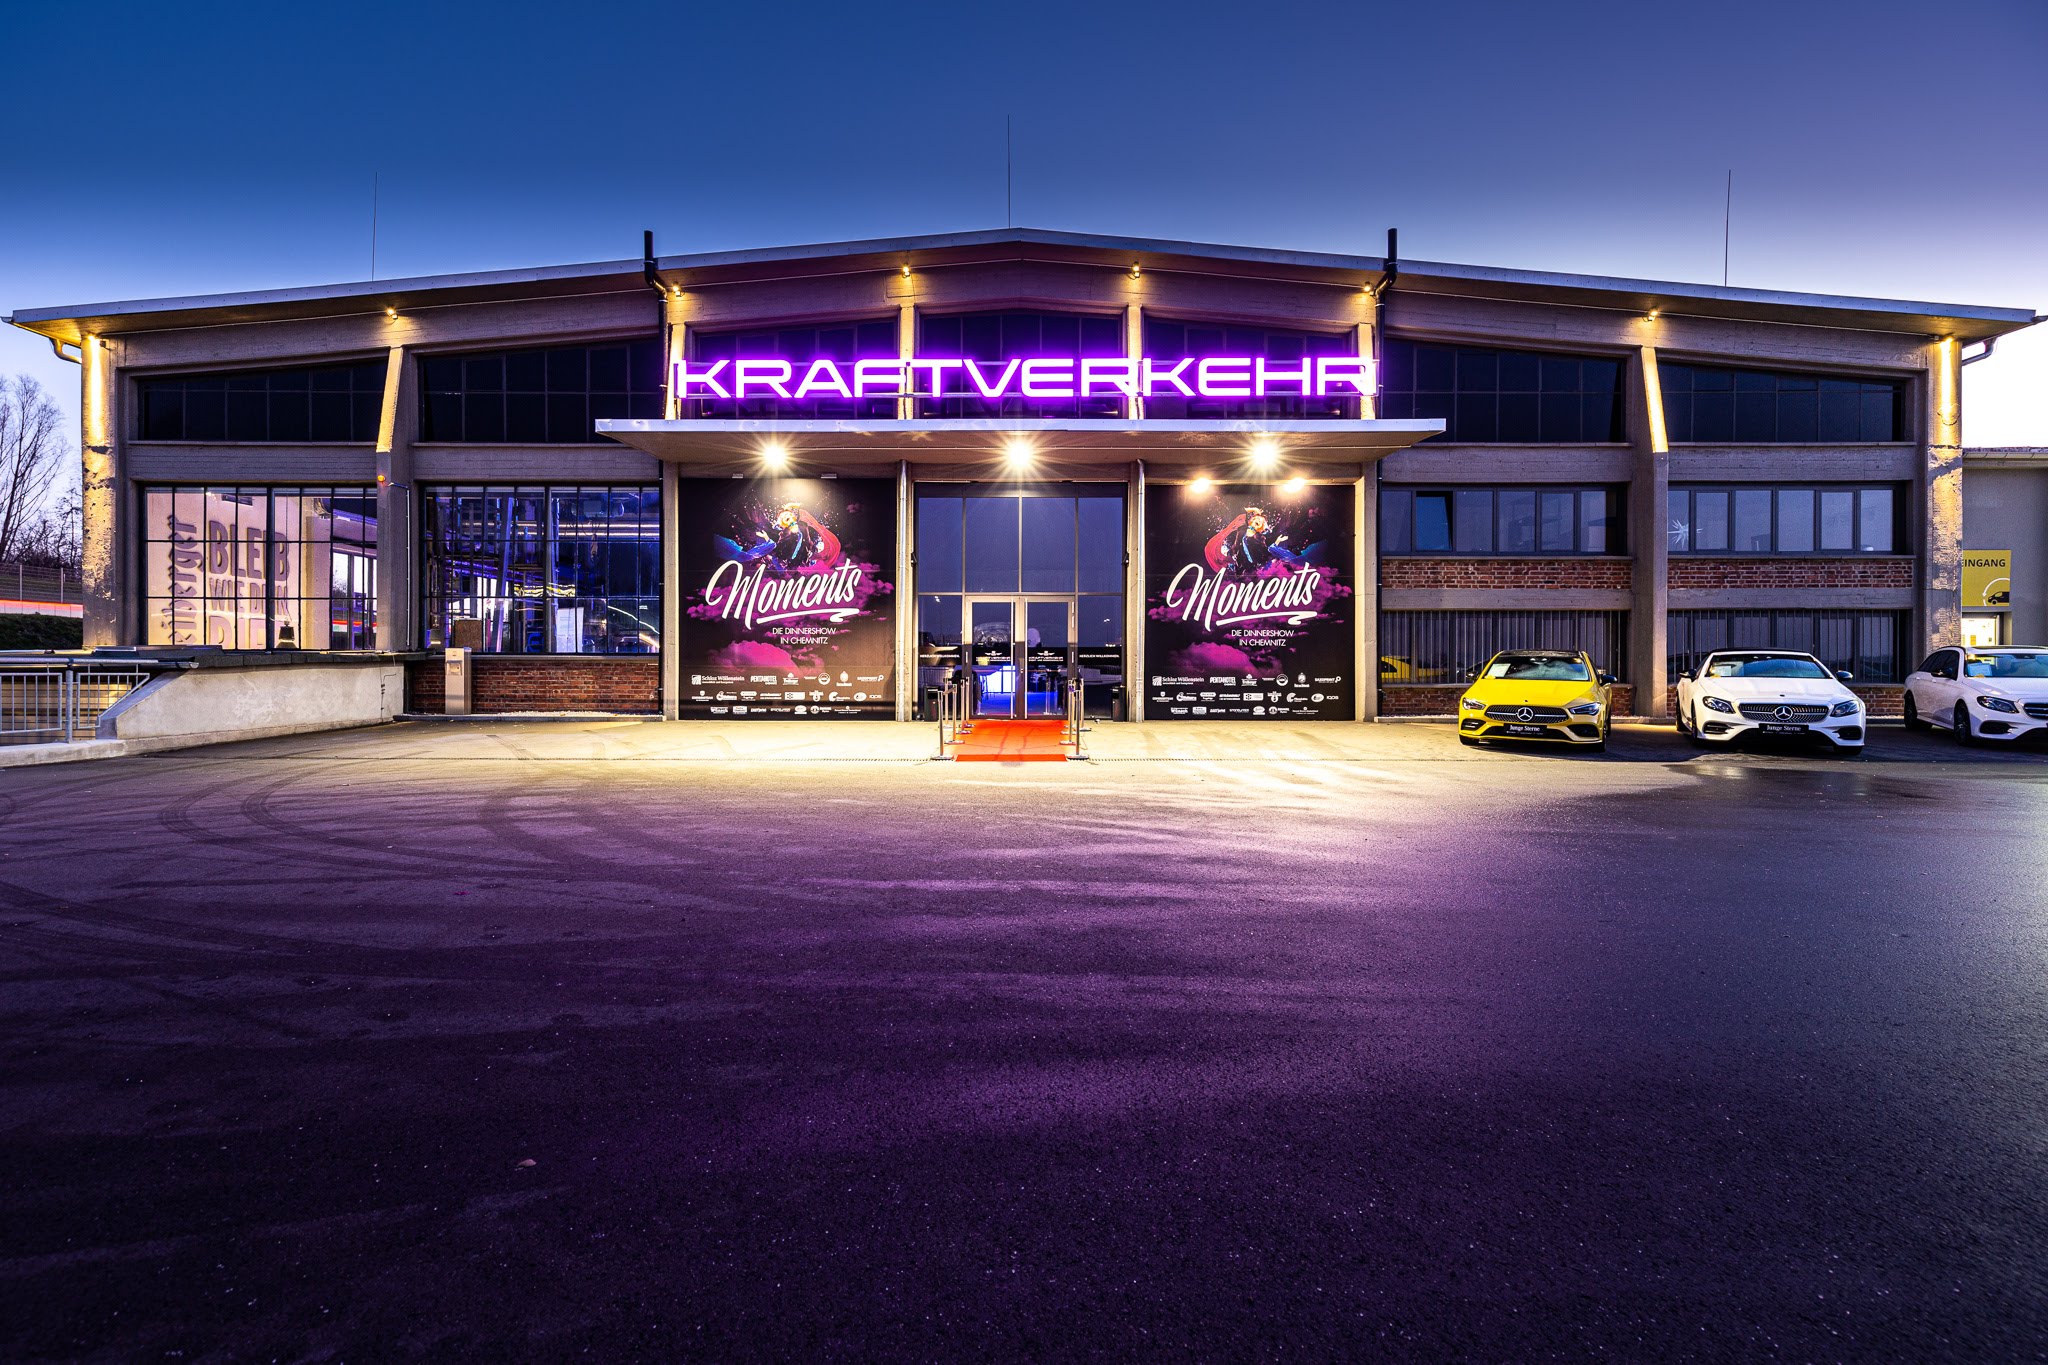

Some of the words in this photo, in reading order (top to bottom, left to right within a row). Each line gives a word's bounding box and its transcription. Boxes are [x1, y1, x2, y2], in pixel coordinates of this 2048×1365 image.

[677, 357, 1376, 398] KRAFTVERKEHR
[706, 558, 861, 630] Moments
[1166, 562, 1320, 631] Moments
[772, 627, 783, 635] DIE
[785, 627, 837, 635] DINNERSHOW
[1231, 629, 1242, 637] DIE
[1244, 629, 1294, 637] DINNERSHOW
[790, 636, 828, 644] CHEMNITZ
[1249, 638, 1286, 646] CHEMNITZ
